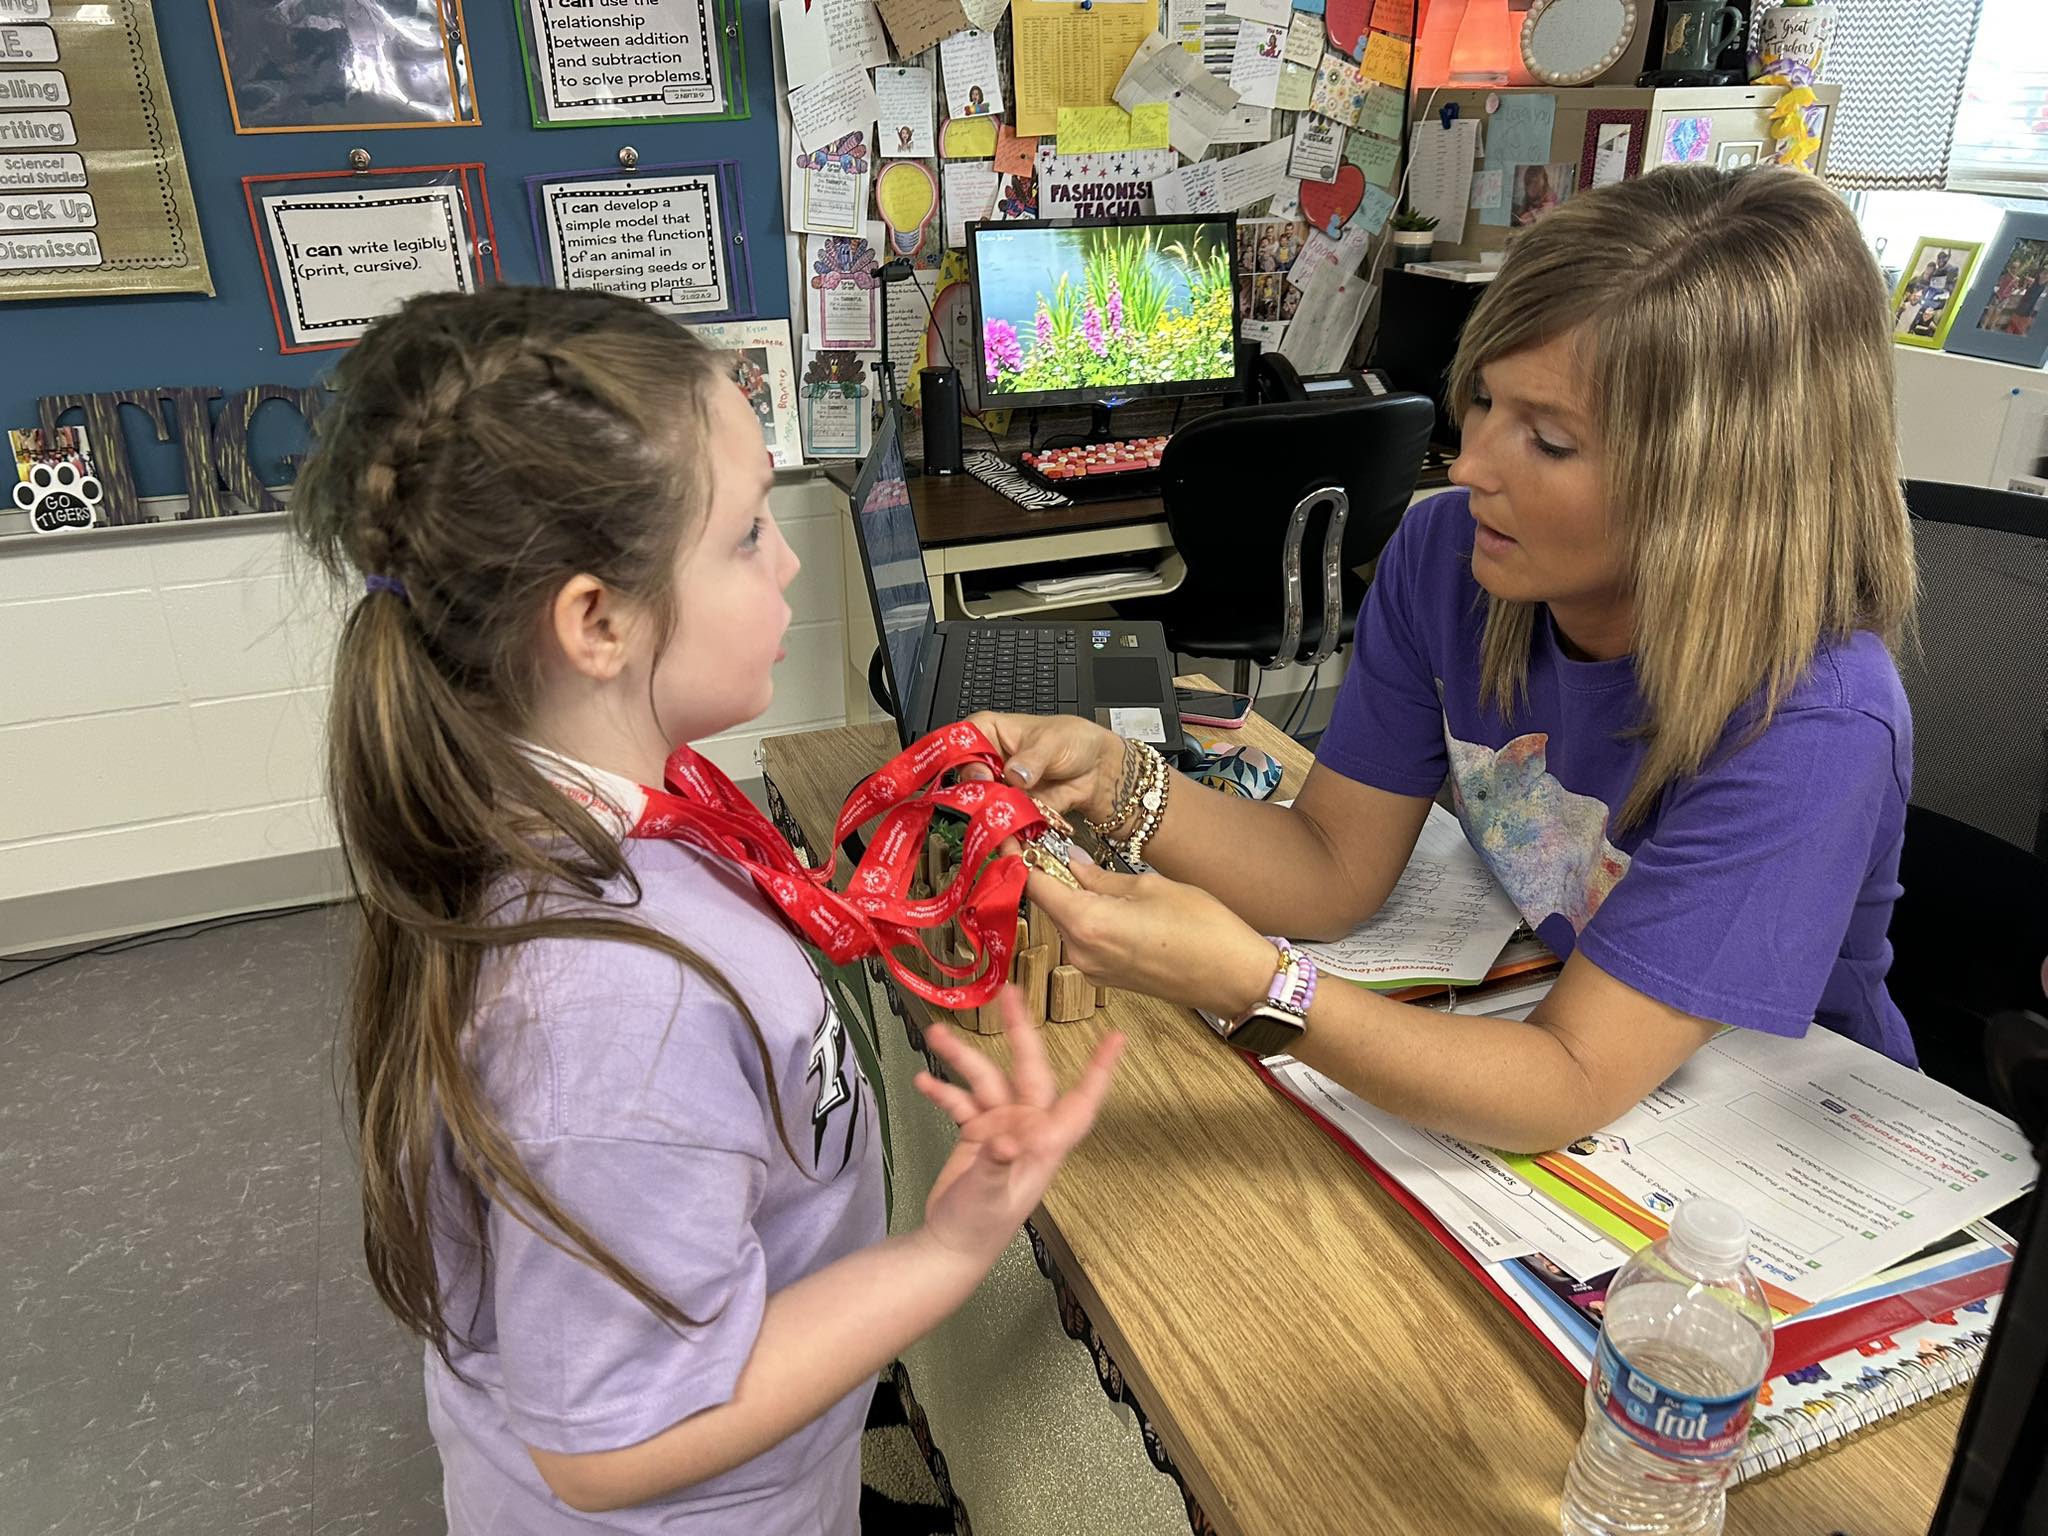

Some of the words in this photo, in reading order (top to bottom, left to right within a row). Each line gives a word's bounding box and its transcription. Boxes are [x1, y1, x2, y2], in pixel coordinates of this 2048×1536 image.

[551, 14, 646, 30] relationship
[1782, 18, 1810, 39] Great
[553, 36, 620, 49] between
[625, 31, 689, 47] addition
[556, 55, 587, 69] and
[591, 52, 682, 67] subtraction
[559, 75, 578, 88] to
[582, 71, 624, 87] solve
[628, 69, 705, 88] problems.
[36, 171, 86, 184] Studies
[60, 199, 92, 223] Up
[562, 202, 568, 215] I
[571, 202, 599, 214] can
[603, 198, 659, 213] develop
[661, 199, 672, 209] a
[565, 218, 612, 234] simple
[615, 215, 659, 228] model
[662, 213, 691, 226] that
[294, 243, 298, 259] I
[305, 244, 343, 258] can
[347, 240, 389, 256] write
[393, 236, 448, 252] legibly
[567, 234, 618, 249] mimics
[621, 233, 645, 245] the
[647, 228, 706, 243] function
[569, 251, 588, 264] of
[590, 252, 607, 262] an
[610, 246, 656, 260] animal
[659, 247, 673, 258] in
[297, 265, 350, 281] (print,
[352, 255, 423, 275] cursive).
[571, 265, 645, 282] dispersing
[648, 264, 688, 275] seeds
[692, 261, 708, 270] or
[650, 276, 697, 292] plants.
[46, 494, 70, 509] GO
[36, 506, 92, 528] TIGERS
[912, 745, 948, 775] Olympics
[914, 738, 944, 762] Special
[878, 820, 904, 862] Olympics
[886, 829, 908, 866] Special
[818, 905, 841, 928] Special
[1846, 1112, 1937, 1163] Understanding
[1453, 1141, 1480, 1161] Week
[1480, 1159, 1517, 1187] Spelling
[1935, 1161, 1979, 1184] Check
[1809, 1187, 1843, 1205] another
[1836, 1179, 1866, 1195] shape
[1787, 1191, 1811, 1205] name
[1810, 1205, 1827, 1214] the
[1832, 1217, 1860, 1231] What
[1760, 1262, 1796, 1281] Build
